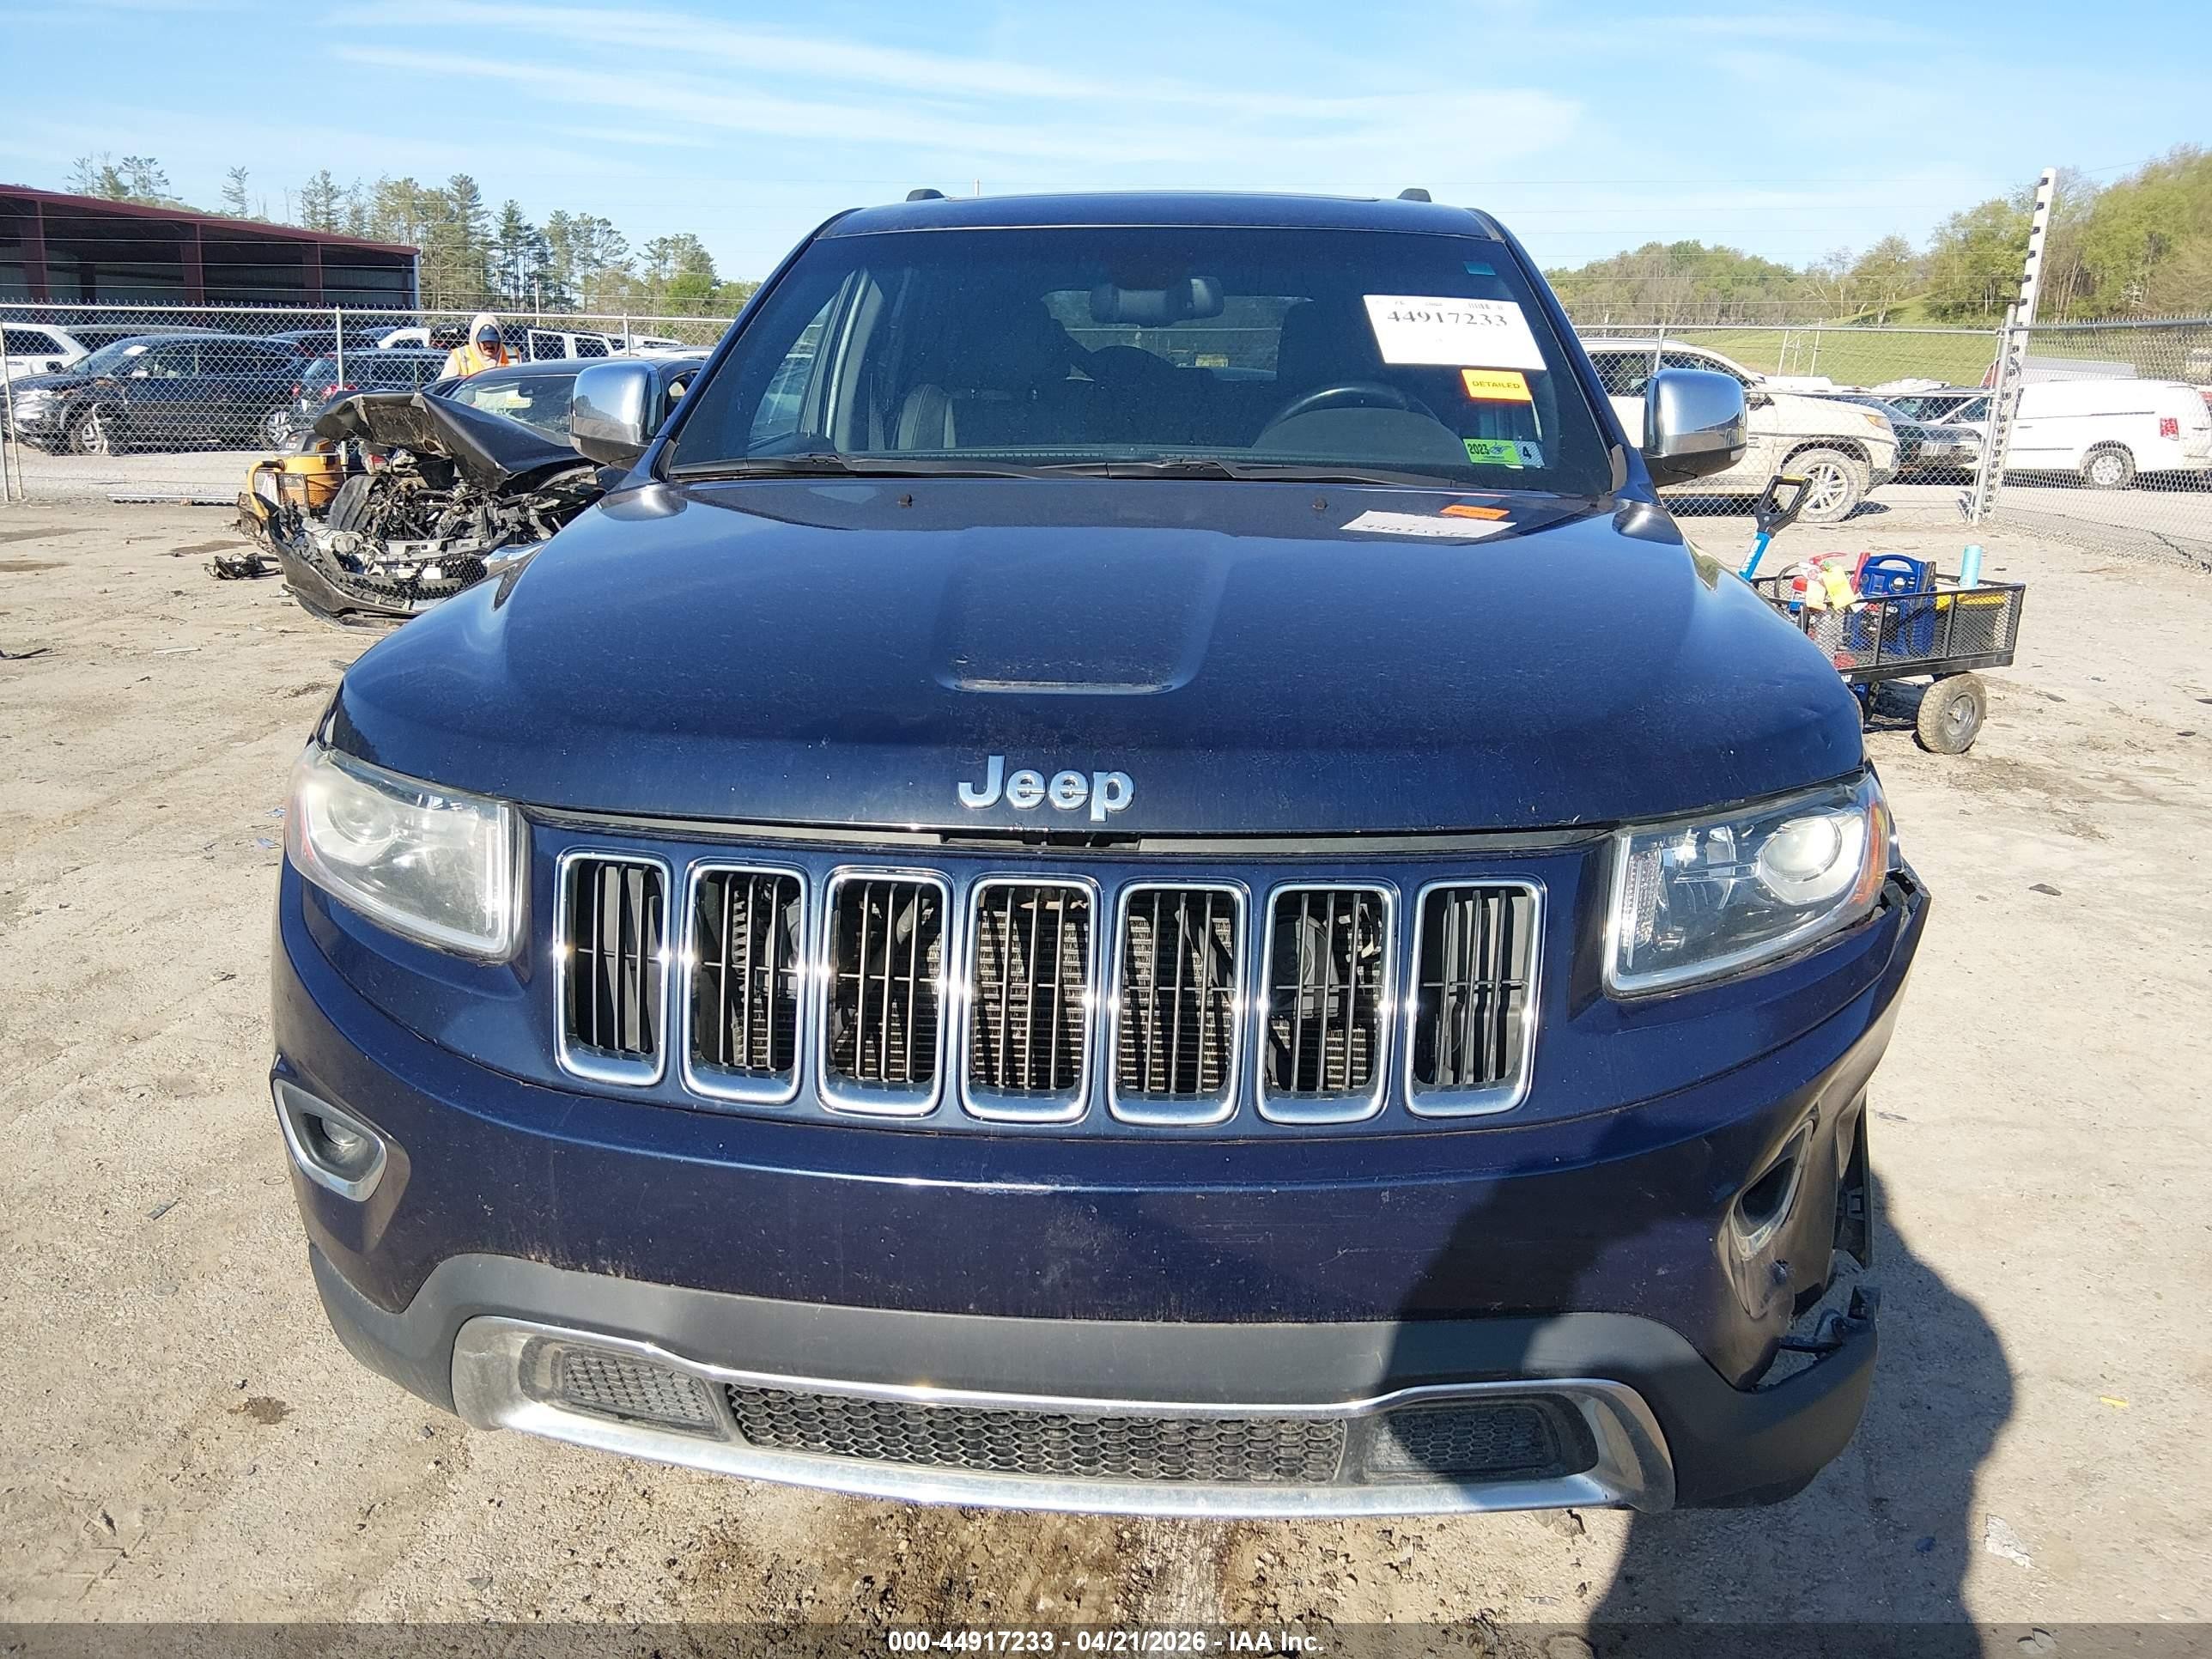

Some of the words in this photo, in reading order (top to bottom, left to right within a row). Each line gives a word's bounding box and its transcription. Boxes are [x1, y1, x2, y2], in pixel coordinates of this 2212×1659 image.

[1388, 310, 1507, 326] 44917233
[1472, 380, 1521, 389] DETAILED
[1468, 443, 1490, 455] 2023
[1522, 446, 1532, 459] 4
[957, 755, 1134, 822] Jeep
